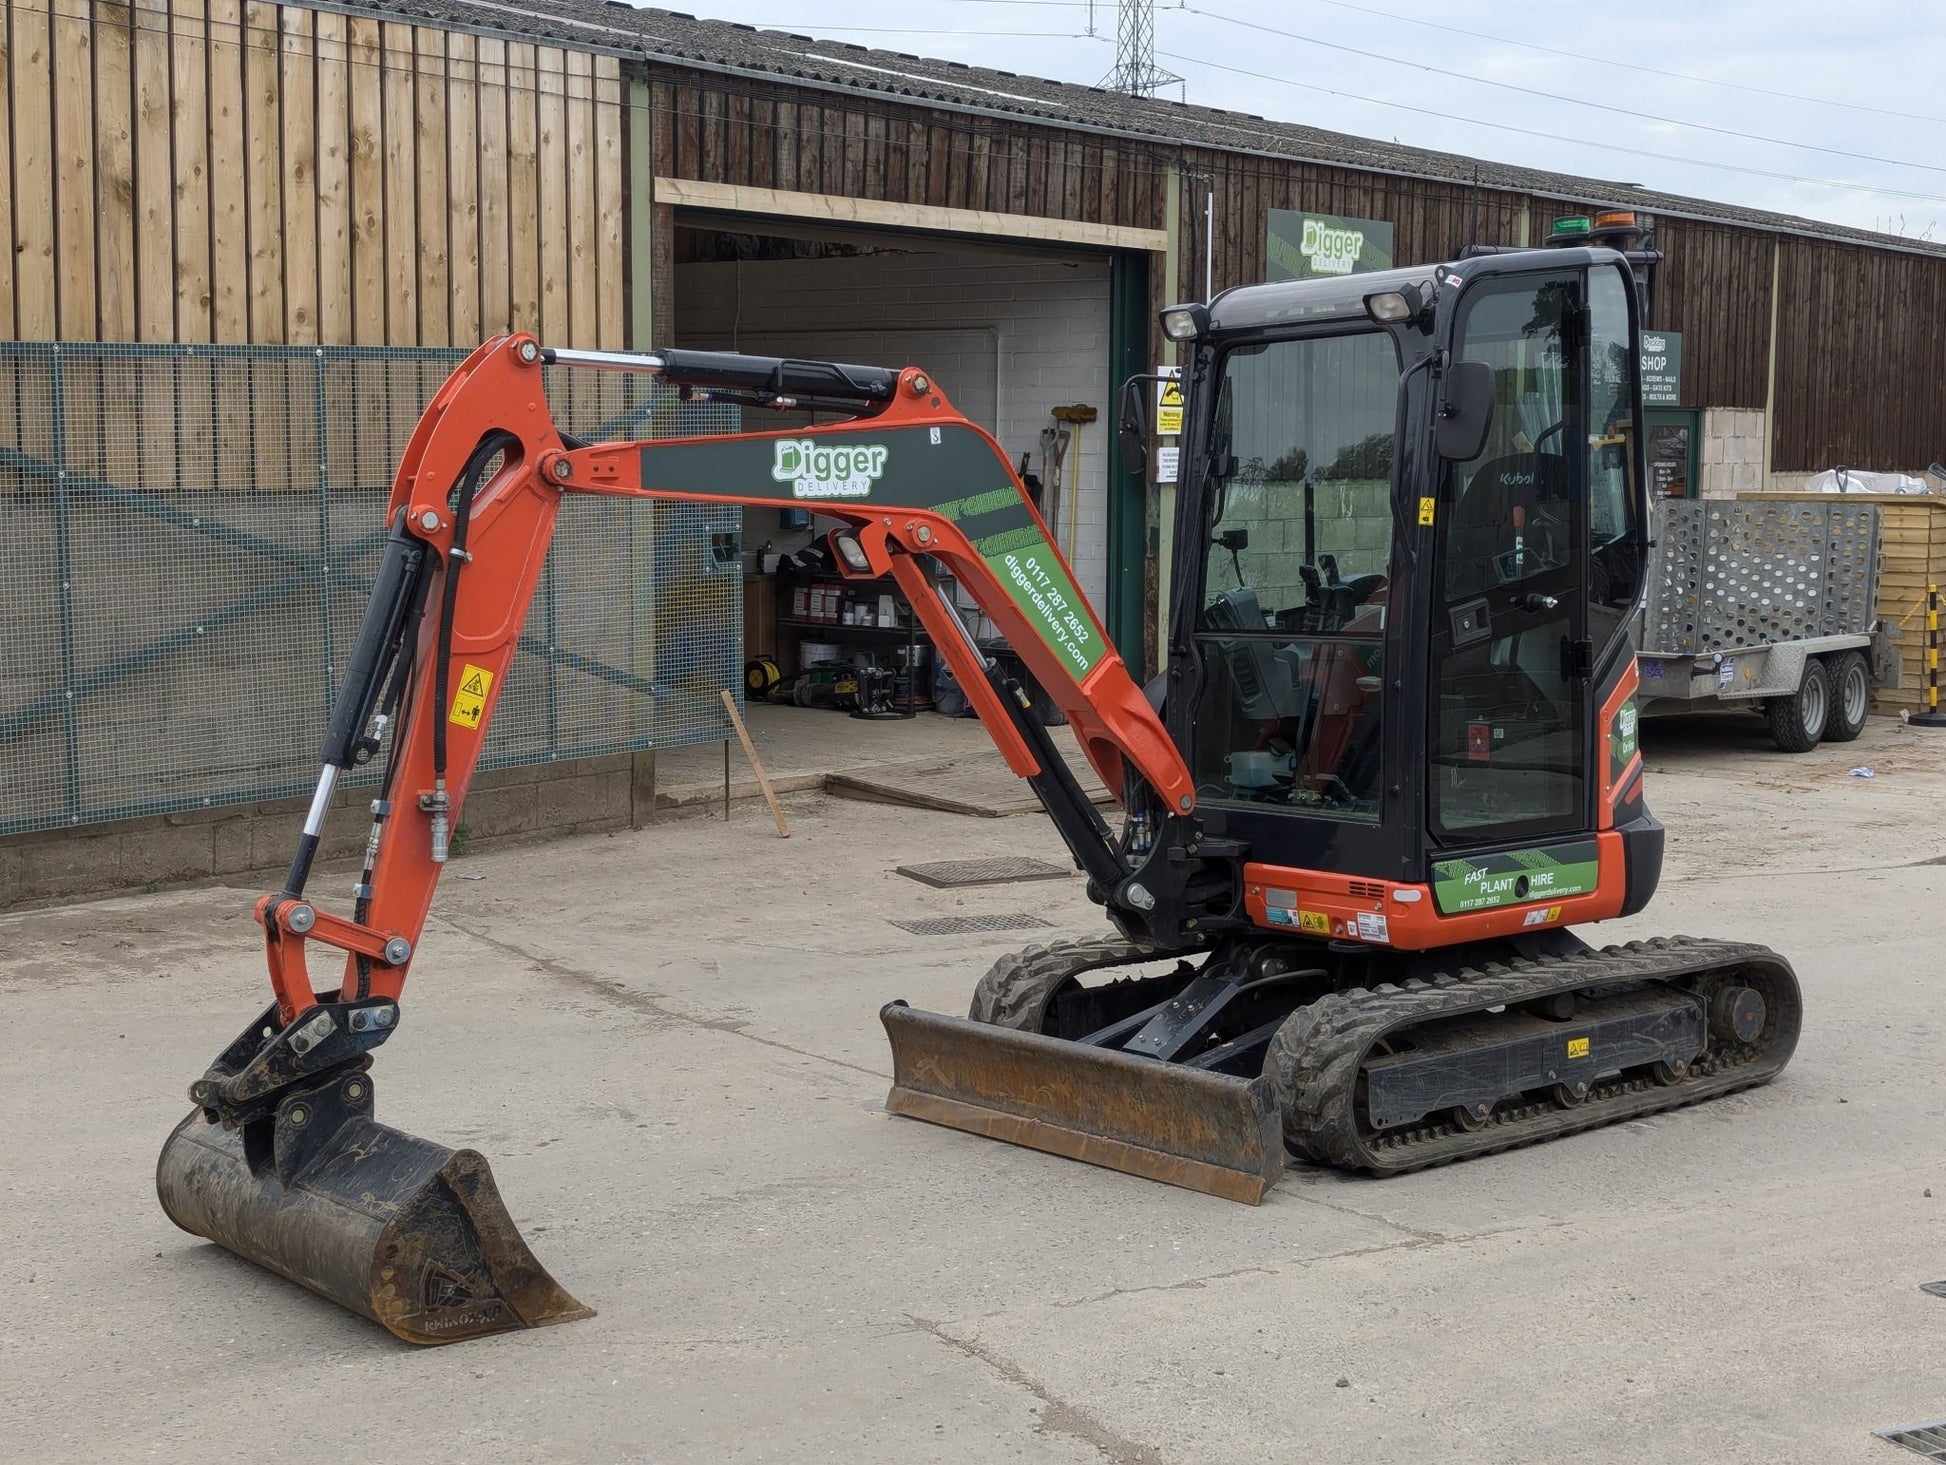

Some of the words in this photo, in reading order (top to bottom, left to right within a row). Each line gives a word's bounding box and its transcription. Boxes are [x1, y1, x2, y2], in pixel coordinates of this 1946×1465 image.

[1304, 222, 1362, 259] Digger
[1641, 355, 1667, 371] SHOP
[777, 443, 883, 482] Digger
[797, 480, 868, 492] DELIVERY
[1026, 557, 1051, 587] 0117
[1047, 588, 1068, 611] 287
[1064, 611, 1089, 644] 2652
[1005, 555, 1089, 670] diggerdelivery.com
[1464, 867, 1489, 886] FAST
[1480, 878, 1514, 893] PLANT
[1530, 873, 1555, 887] HIRE
[1460, 898, 1475, 908] 0117
[1475, 897, 1486, 907] 287
[1487, 895, 1500, 905] 2652
[1528, 886, 1581, 899] diggerdelivery.com
